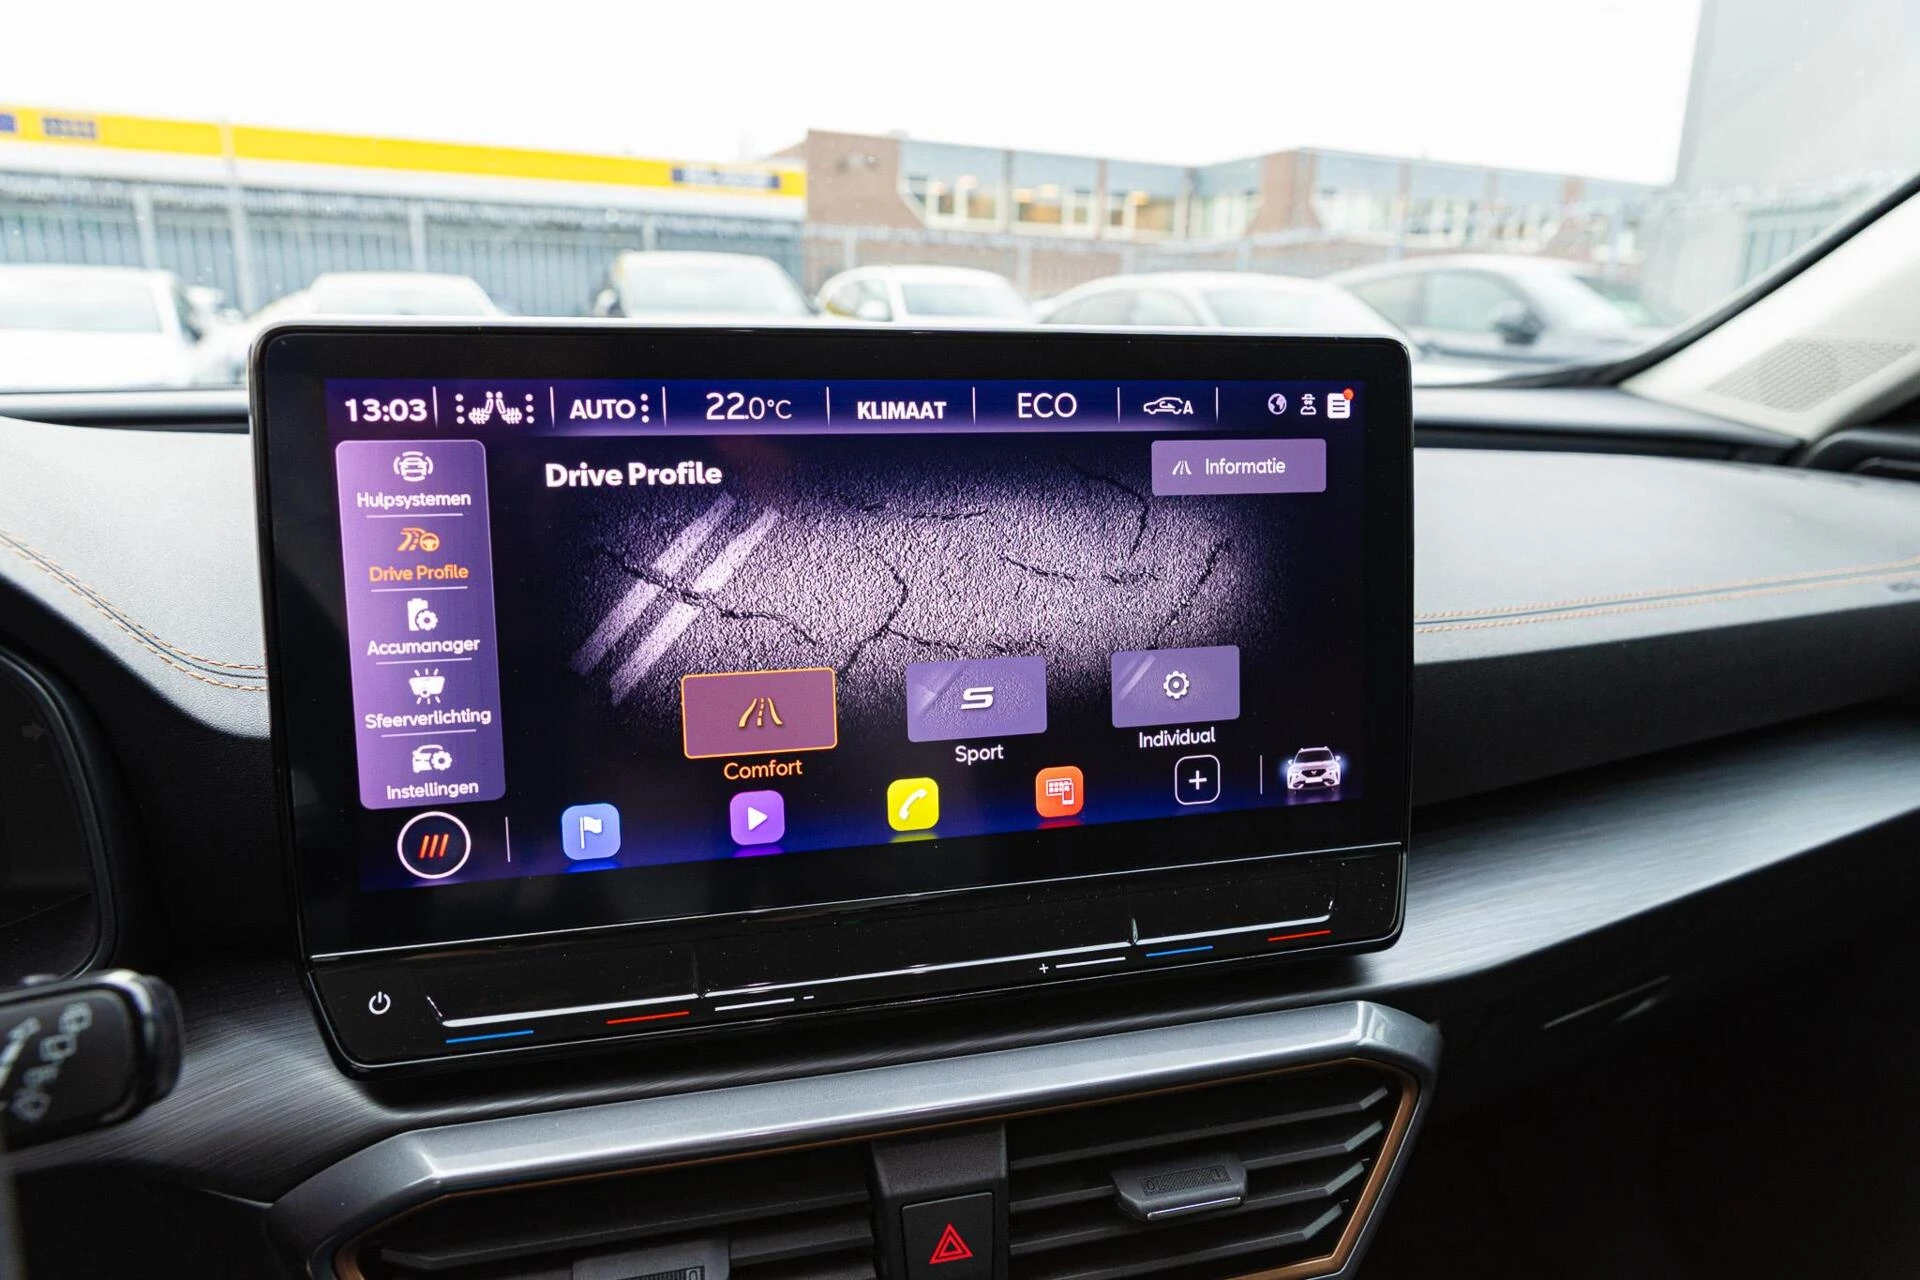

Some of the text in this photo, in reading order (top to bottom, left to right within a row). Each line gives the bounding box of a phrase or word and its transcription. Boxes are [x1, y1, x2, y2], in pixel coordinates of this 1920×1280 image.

[344, 398, 427, 421] 13:03
[569, 398, 636, 420] AUTO
[857, 401, 947, 420] KLIMAAT
[1017, 392, 1078, 419] ECO
[545, 461, 723, 487] Drive Profile
[1205, 457, 1287, 476] Informatie
[356, 492, 472, 511] Hulpsystemen
[369, 564, 469, 583] Drive Profile
[366, 639, 481, 656] Accumanager
[364, 708, 492, 730] Sfeerverlichting
[1138, 726, 1217, 749] Individual
[955, 744, 1004, 766] Sport
[724, 757, 804, 781] Comfort
[387, 781, 479, 800] Instellingen
